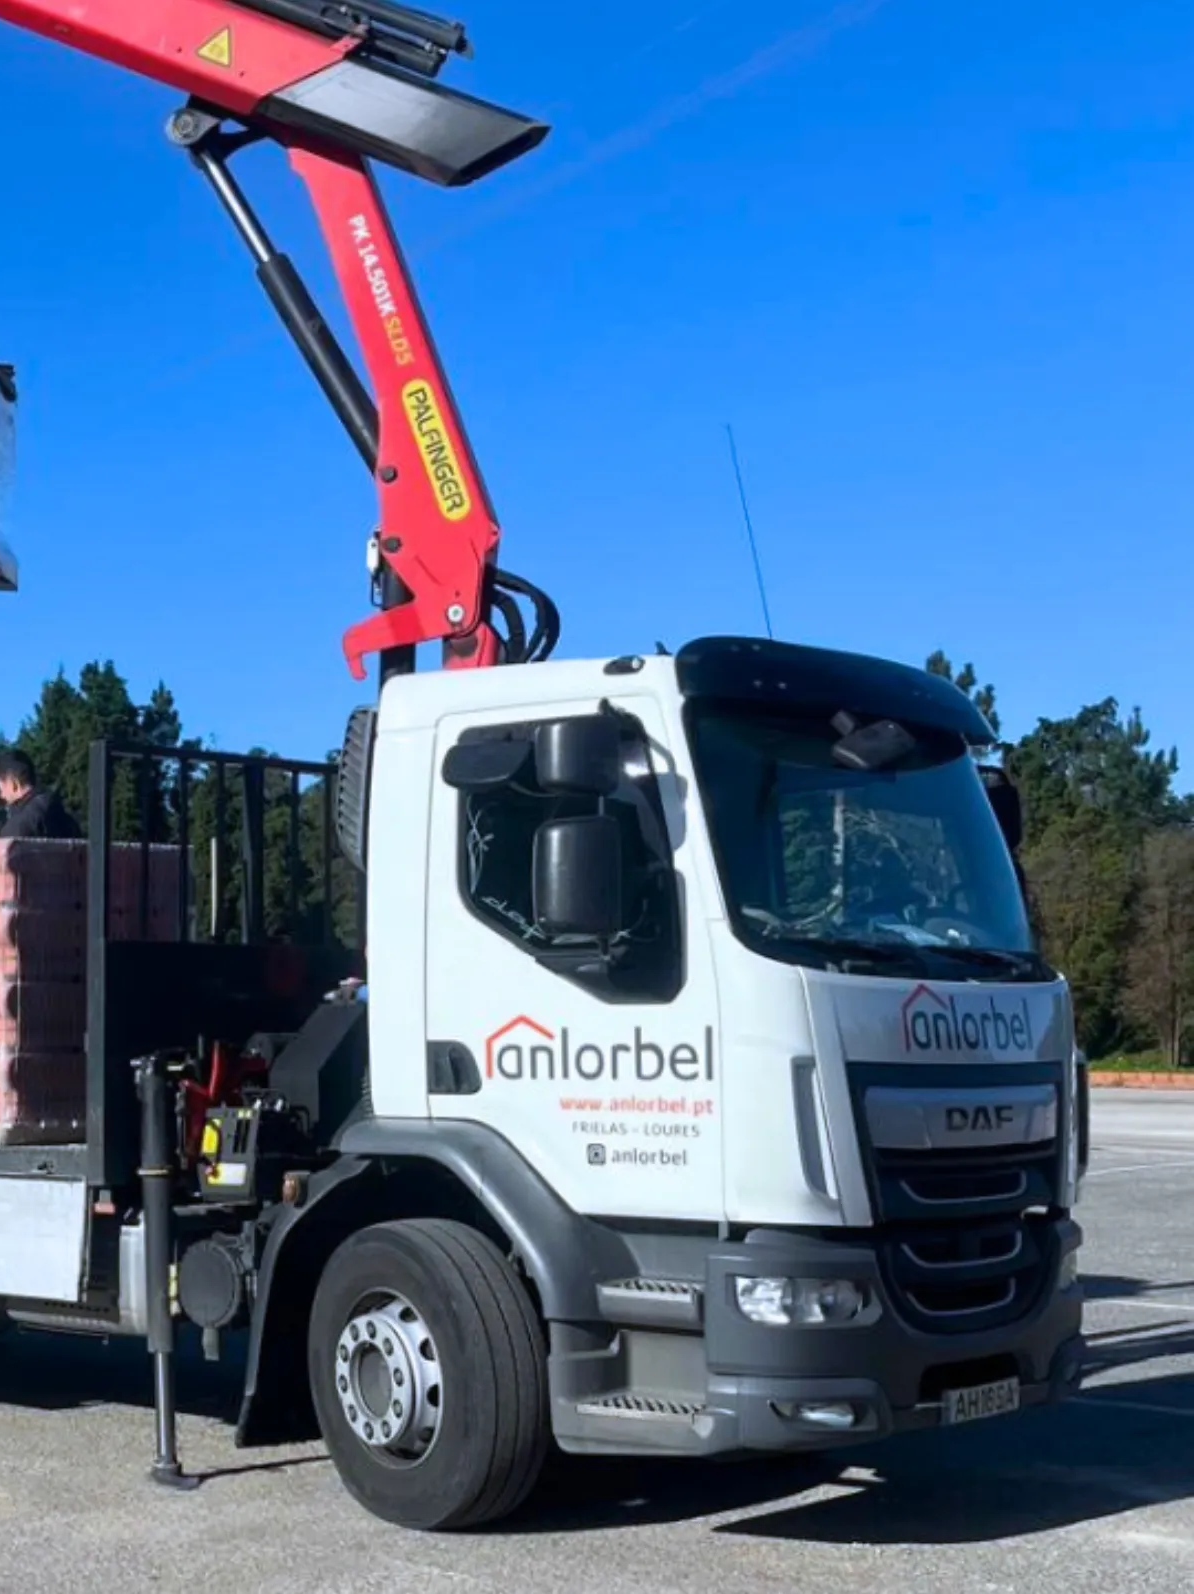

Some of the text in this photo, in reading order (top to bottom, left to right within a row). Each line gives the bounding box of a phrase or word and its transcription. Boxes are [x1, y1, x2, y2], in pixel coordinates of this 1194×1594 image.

[348, 213, 373, 241] PK
[406, 386, 466, 514] PALFINGER
[910, 994, 1033, 1051] anlorbel
[496, 1025, 714, 1081] anlorbel
[559, 1096, 714, 1117] www.anlorbel.pt
[945, 1105, 1014, 1132] DAF
[572, 1120, 628, 1136] FRIELAS
[644, 1122, 701, 1138] LOURES
[611, 1146, 687, 1167] anlorbel
